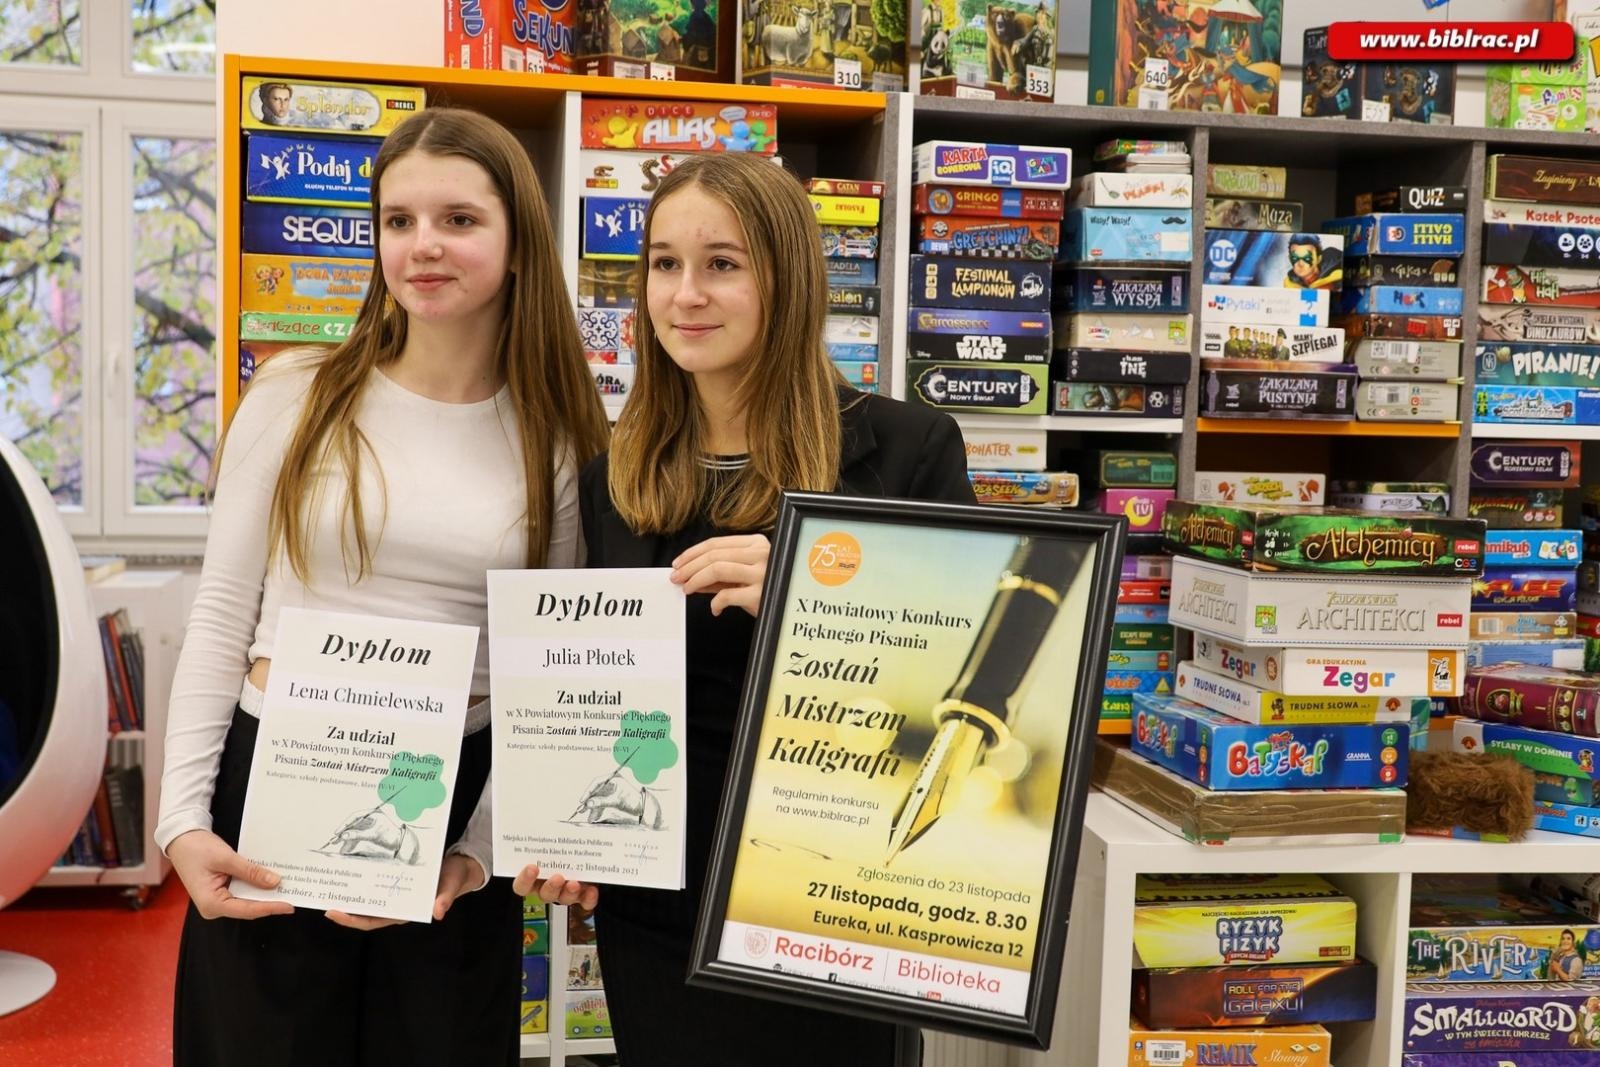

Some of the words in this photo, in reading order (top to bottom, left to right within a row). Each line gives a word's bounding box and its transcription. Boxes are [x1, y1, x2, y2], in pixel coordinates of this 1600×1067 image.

[836, 71, 860, 86] 310
[1029, 78, 1049, 94] 353
[1145, 70, 1168, 84] 640
[296, 95, 373, 119] Splendor
[643, 117, 717, 149] ALIAS
[943, 147, 988, 165] KARTA
[297, 151, 351, 185] Podaj
[837, 183, 860, 192] CATAN
[956, 192, 999, 202] GRINGO
[1409, 188, 1445, 209] QUIZ
[1526, 209, 1562, 223] Kotek
[1413, 224, 1452, 234] GALLI
[1413, 235, 1452, 245] HALLI
[1212, 246, 1235, 262] DC
[955, 268, 1012, 284] FESTIWAL
[1112, 280, 1163, 294] ZAKAZANA
[1112, 293, 1164, 308] WYSPA
[956, 336, 1006, 349] STAR
[1291, 335, 1338, 356] SZPIEGA!
[957, 347, 1006, 360] WARS
[1512, 351, 1600, 380] PIRANIE!
[927, 374, 1018, 399] CENTURY
[1259, 377, 1318, 391] ZAKAZANA
[1259, 391, 1317, 407] PUSTYNIA
[966, 443, 1012, 457] BOHATER
[1488, 451, 1554, 471] CENTURY
[1180, 512, 1235, 554] Alchemicy
[812, 543, 837, 567] 75
[1306, 526, 1436, 567] Alchemicy
[1457, 543, 1477, 551] rebel
[1454, 557, 1477, 569] CGE
[1487, 579, 1568, 598] FUSE
[535, 592, 643, 622] Dyplom
[796, 598, 809, 613] X
[812, 599, 898, 624] Powiatowy
[902, 608, 973, 629] Konkurs
[1178, 592, 1238, 625] ARCHITEKCI
[1297, 608, 1426, 632] ARCHITEKCI
[1440, 617, 1460, 625] rebel
[792, 622, 865, 645] Pięknego
[869, 630, 929, 650] Pisania
[320, 633, 432, 666] Dyplom
[542, 648, 581, 668] Julia
[587, 649, 636, 666] Płotek
[783, 651, 880, 685] Zostań
[1220, 649, 1257, 680] Zegar
[1306, 658, 1322, 666] GRA
[1322, 658, 1367, 666] EDUKACYJNA
[1193, 676, 1218, 697] TRUDNE
[1218, 685, 1242, 704] SŁOWA
[1323, 666, 1395, 694] Zegar
[289, 682, 328, 701] Lena
[334, 687, 444, 714] Chmielewska
[556, 690, 574, 705] Za
[578, 690, 622, 706] udział
[1290, 702, 1322, 711] TRUDNE
[1324, 700, 1359, 710] SŁOWA
[506, 710, 516, 718] w
[516, 708, 523, 718] X
[525, 708, 581, 722] Powiatowym
[583, 709, 629, 721] Konkursie
[631, 712, 671, 724] Pięknego
[776, 694, 908, 732] Mistrzem
[327, 726, 345, 740] Za
[350, 729, 395, 746] udział
[512, 725, 544, 735] Pisania
[546, 725, 577, 737] Zostań
[578, 726, 621, 738] Mistrzem
[623, 728, 666, 740] Kaligrafii
[271, 739, 280, 747] w
[281, 738, 289, 748] X
[290, 740, 349, 756] Powiatowym
[352, 746, 400, 761] Konkursie
[402, 753, 445, 767] Pięknego
[768, 737, 903, 780] Kaligrafii
[1346, 752, 1371, 760] GRANNA
[1491, 740, 1522, 751] SYLABY
[1523, 745, 1534, 753] W
[1535, 747, 1573, 760] DOMINIE
[275, 753, 308, 766] Pisania
[309, 758, 343, 771] Zostań
[345, 762, 389, 775] Mistrzem
[391, 767, 436, 782] Kaligrafii
[772, 786, 829, 802] Regulamin
[831, 792, 880, 811] konkursu
[775, 804, 790, 814] na
[792, 806, 870, 827] www.biblrac.pl
[585, 862, 620, 874] listopada
[856, 866, 925, 888] Zgłoszenia
[927, 877, 945, 890] do
[949, 880, 964, 893] 23
[967, 883, 1031, 904] listopada
[328, 893, 366, 904] listopada
[807, 882, 828, 898] 27
[831, 885, 924, 917] listopada,
[928, 900, 980, 924] godz.
[985, 911, 1028, 931] 8.30
[813, 910, 872, 934] Eureka,
[875, 920, 894, 936] ul.
[898, 924, 1004, 954] Kasprowicza
[1008, 942, 1024, 957] 12
[1218, 919, 1282, 936] RYZYK
[775, 935, 875, 971] Racibórz
[1221, 936, 1278, 953] FIZYK
[1412, 938, 1441, 961] THE
[1445, 935, 1527, 975] RIVER
[897, 958, 1001, 993] Biblioteka
[1228, 985, 1254, 995] ROLL
[1257, 984, 1277, 994] FOR
[1279, 983, 1300, 993] THE
[1445, 1033, 1454, 1041] W
[1455, 1031, 1472, 1040] TYM
[1473, 1029, 1512, 1039] ŚWIECIE
[1513, 1030, 1551, 1041] UMRZESZ
[1196, 1043, 1257, 1067] REMIK
